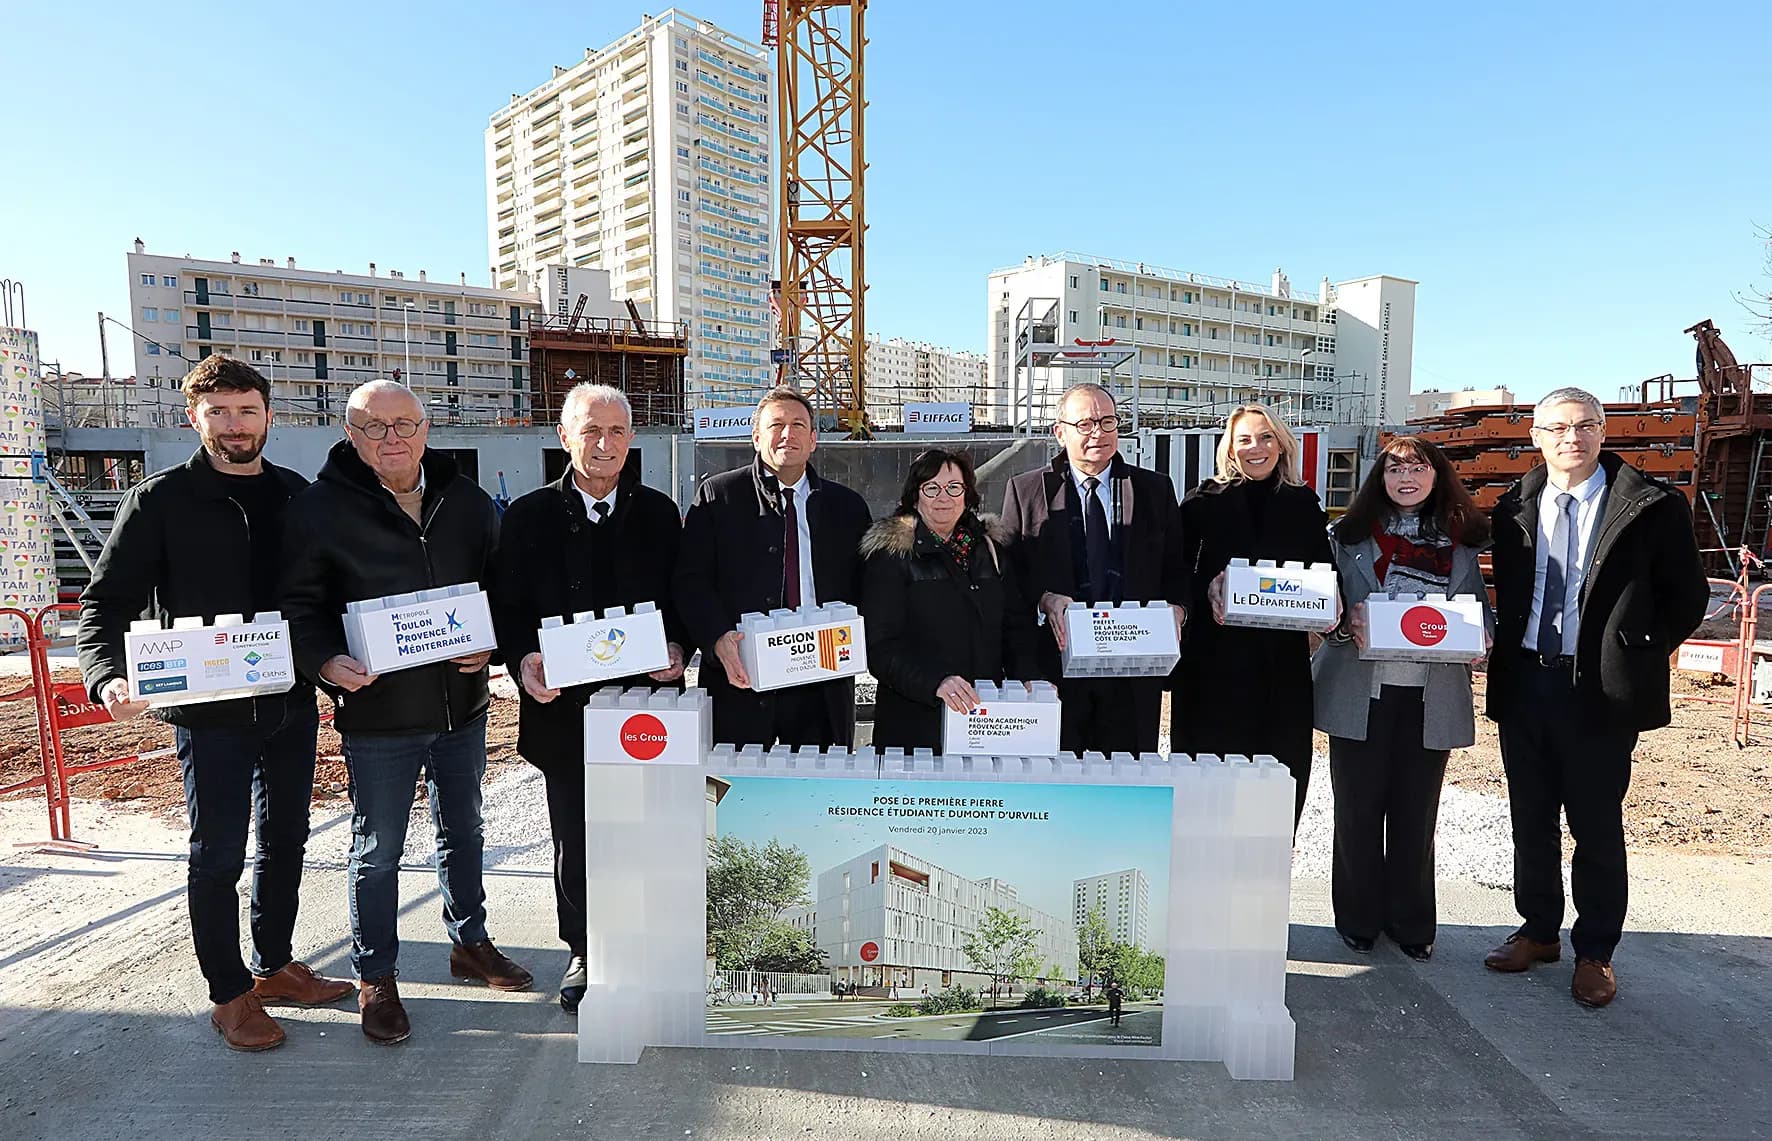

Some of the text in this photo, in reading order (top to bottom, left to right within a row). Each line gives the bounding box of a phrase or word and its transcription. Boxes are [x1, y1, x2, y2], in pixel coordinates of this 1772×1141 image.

[0, 337, 18, 347] AM
[12, 352, 33, 363] TAM
[1, 392, 27, 402] TAM
[923, 414, 965, 423] EIFFAGE
[0, 432, 18, 441] AM
[22, 502, 43, 510] TAM
[11, 541, 37, 549] TAM
[393, 618, 432, 632] TOULON
[232, 630, 281, 643] EIFFAGE
[396, 628, 447, 644] PROVENCE
[768, 631, 815, 647] REGION
[398, 634, 472, 656] MÉDITERRANÉE
[791, 643, 816, 656] SUD
[624, 732, 669, 742] les Crous
[873, 796, 1004, 808] POSE DE PREMIÈRE PIERRE
[828, 807, 1049, 820] RÉSIDENCE ÉTUDIANTE DUMONT D'URVILLE
[888, 826, 988, 836] Vendredi 20 janvier 2023
